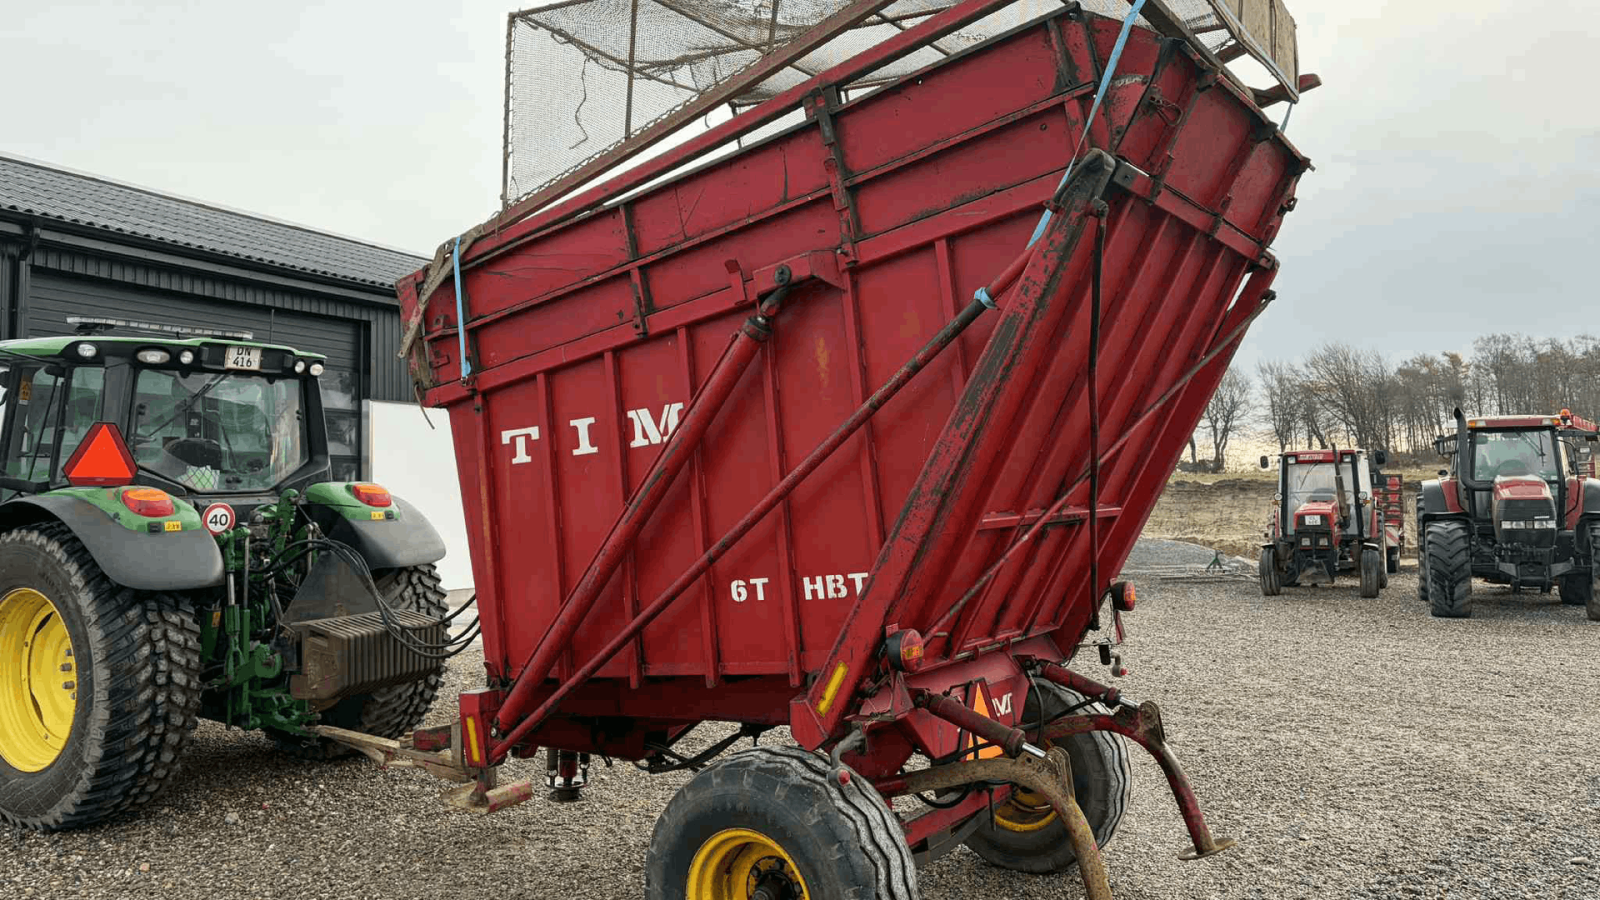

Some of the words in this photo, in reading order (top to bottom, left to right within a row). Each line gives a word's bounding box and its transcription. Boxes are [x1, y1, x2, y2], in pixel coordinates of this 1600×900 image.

[237, 346, 251, 356] DN
[233, 356, 252, 367] 416
[209, 513, 228, 526] 40
[731, 579, 769, 602] 6T
[803, 572, 869, 600] HBT
